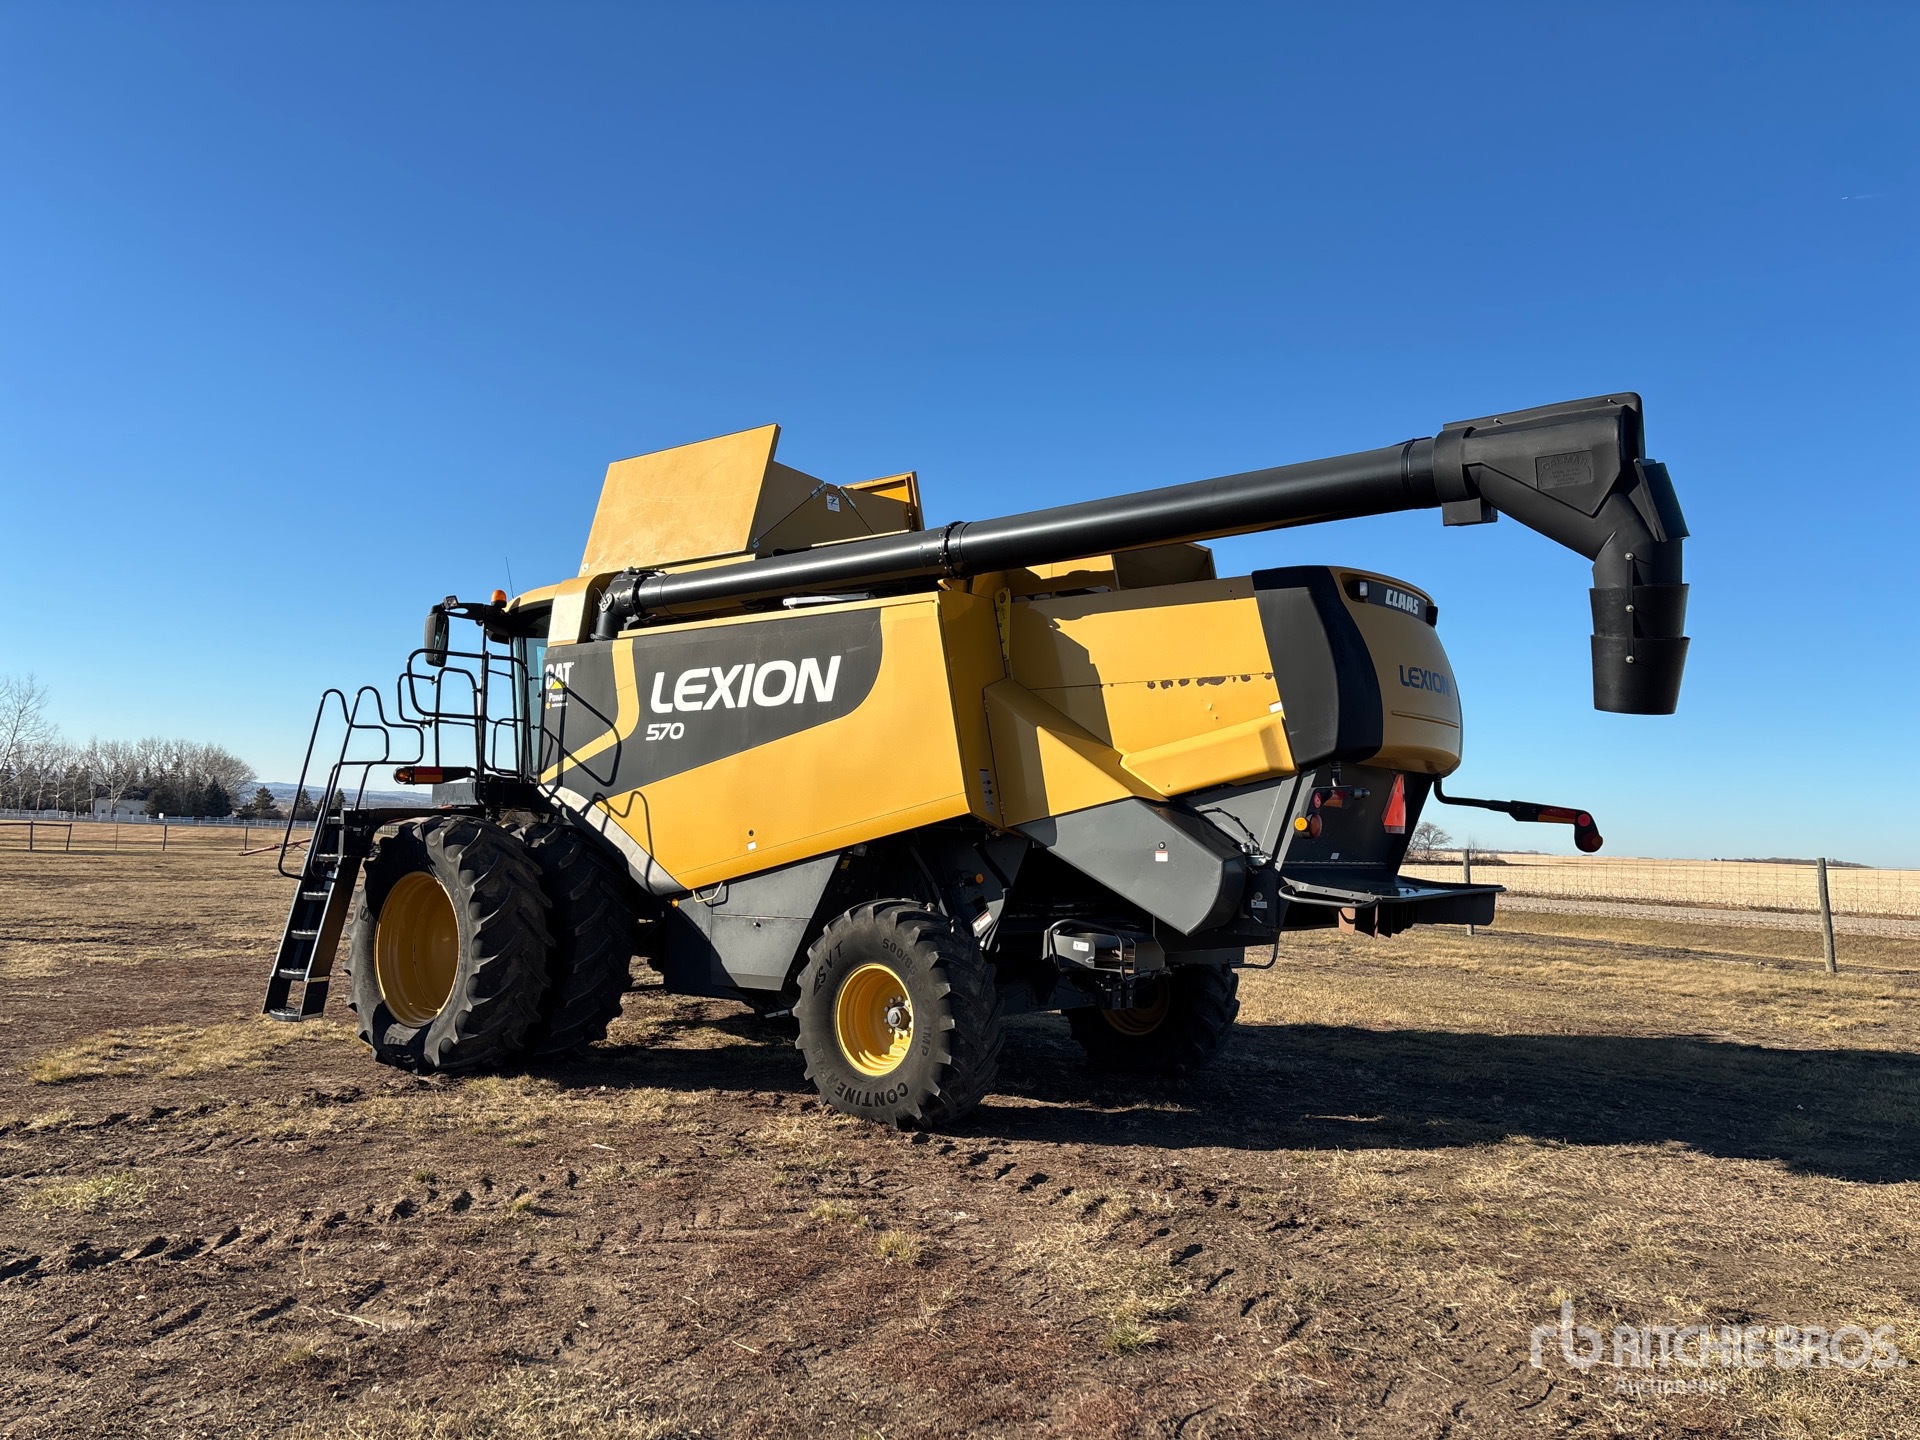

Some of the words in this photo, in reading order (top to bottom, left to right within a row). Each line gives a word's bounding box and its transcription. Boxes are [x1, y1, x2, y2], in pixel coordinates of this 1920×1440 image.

[1385, 588, 1419, 614] CLAAS
[545, 661, 573, 690] CAT
[650, 655, 841, 714] LEXION
[1399, 664, 1451, 697] LEXION
[645, 722, 685, 741] 570
